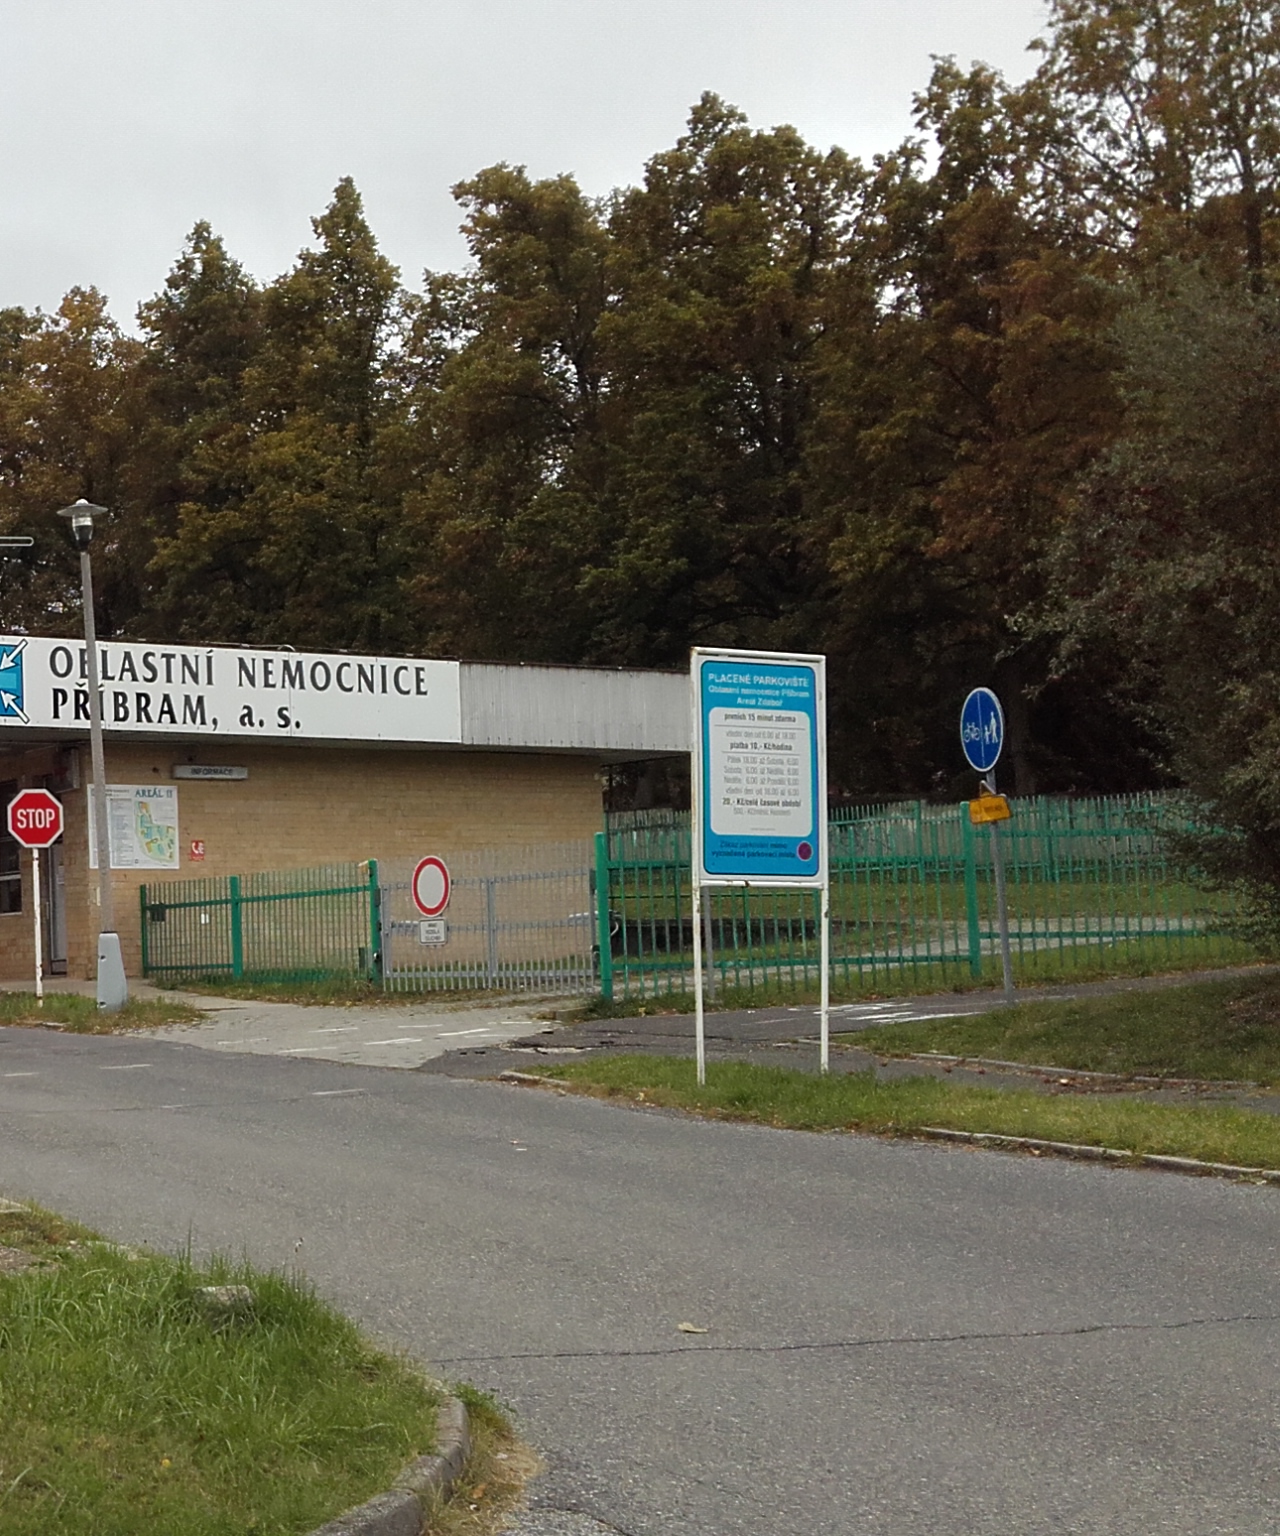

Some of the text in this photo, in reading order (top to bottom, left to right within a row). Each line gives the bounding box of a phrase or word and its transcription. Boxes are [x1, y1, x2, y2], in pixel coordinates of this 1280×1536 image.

[237, 656, 429, 696] NEMOCNICE
[708, 673, 810, 688] PLACENÉ PARKOVIŠTĚ
[51, 681, 302, 731] PŘÍBRAM, a. s.
[748, 713, 756, 721] 15
[775, 714, 796, 722] zdarma
[135, 788, 164, 798] AREÁL
[17, 808, 56, 829] STOP
